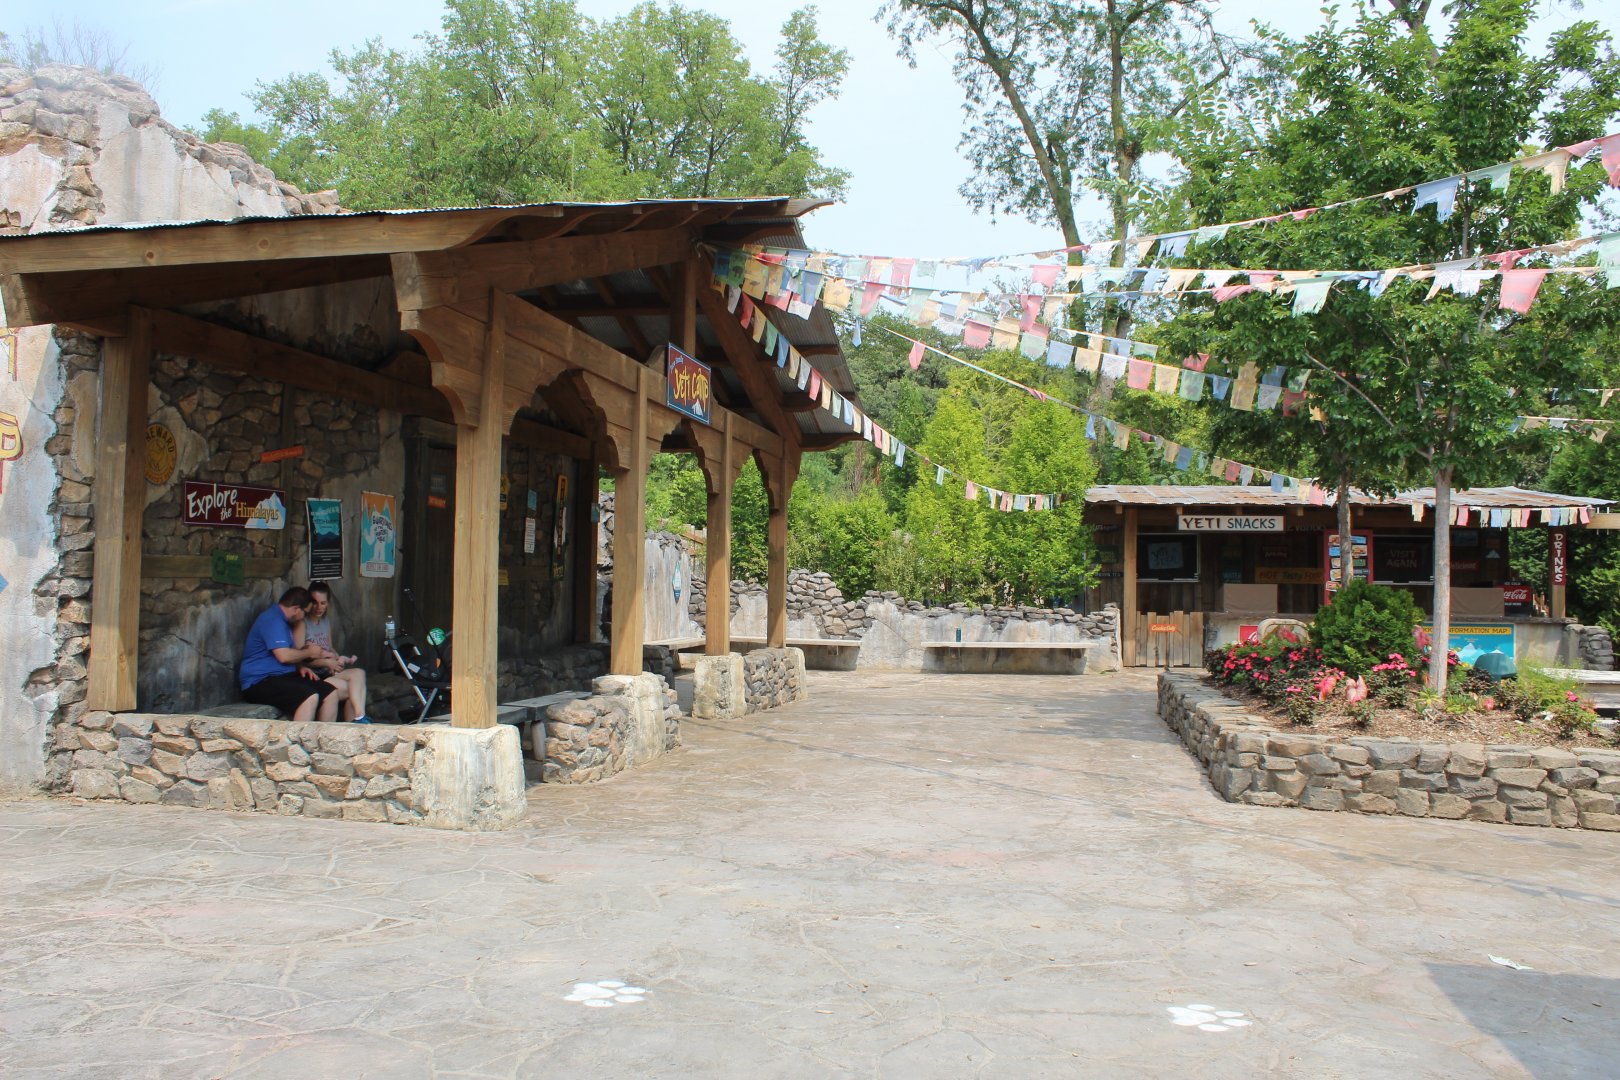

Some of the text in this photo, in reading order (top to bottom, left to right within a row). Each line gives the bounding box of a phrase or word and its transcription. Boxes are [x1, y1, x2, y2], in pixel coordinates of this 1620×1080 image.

[187, 483, 238, 520] Explore
[220, 502, 280, 523] the Himalayas
[1182, 517, 1221, 529] YETI
[1227, 517, 1276, 529] SNACKS
[1386, 559, 1417, 568] AGAIN
[1553, 533, 1564, 583] DRINKS
